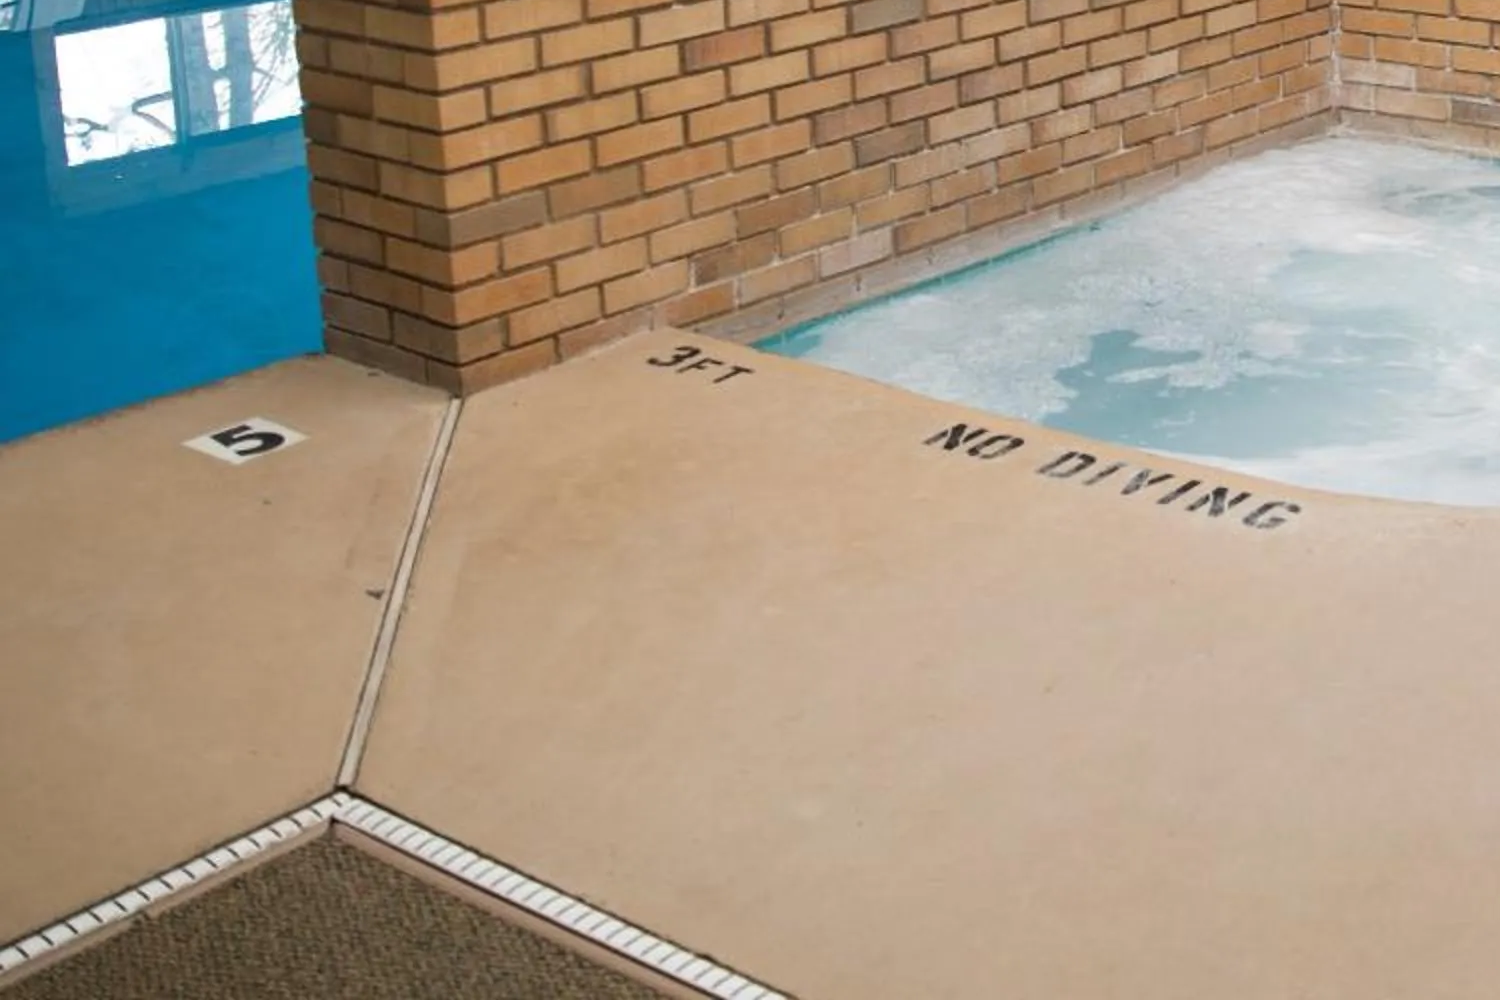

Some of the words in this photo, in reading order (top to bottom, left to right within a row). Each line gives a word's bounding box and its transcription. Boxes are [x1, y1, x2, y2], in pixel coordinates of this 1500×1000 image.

[210, 424, 286, 457] 5
[922, 422, 1025, 460] NO
[1037, 450, 1301, 531] DIVING
